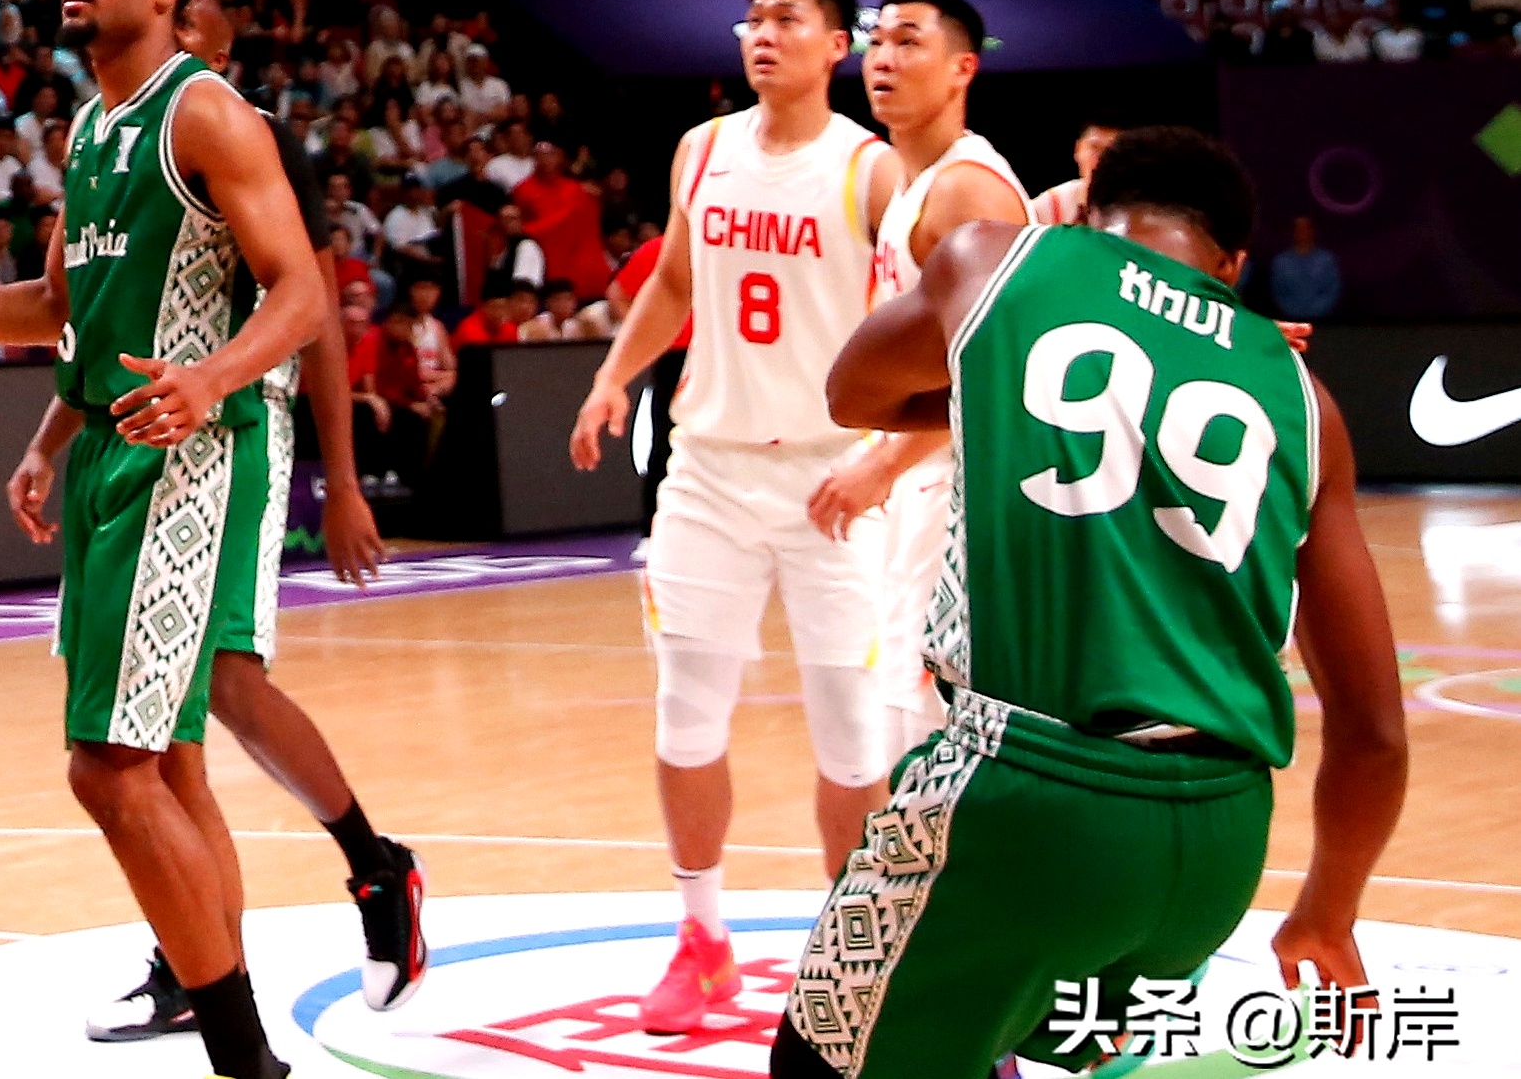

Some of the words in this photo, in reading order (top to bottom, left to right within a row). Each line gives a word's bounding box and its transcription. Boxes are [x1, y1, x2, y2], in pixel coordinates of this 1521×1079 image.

[703, 206, 822, 258] CHINA
[740, 272, 780, 345] 8
[1019, 321, 1278, 574] 99
